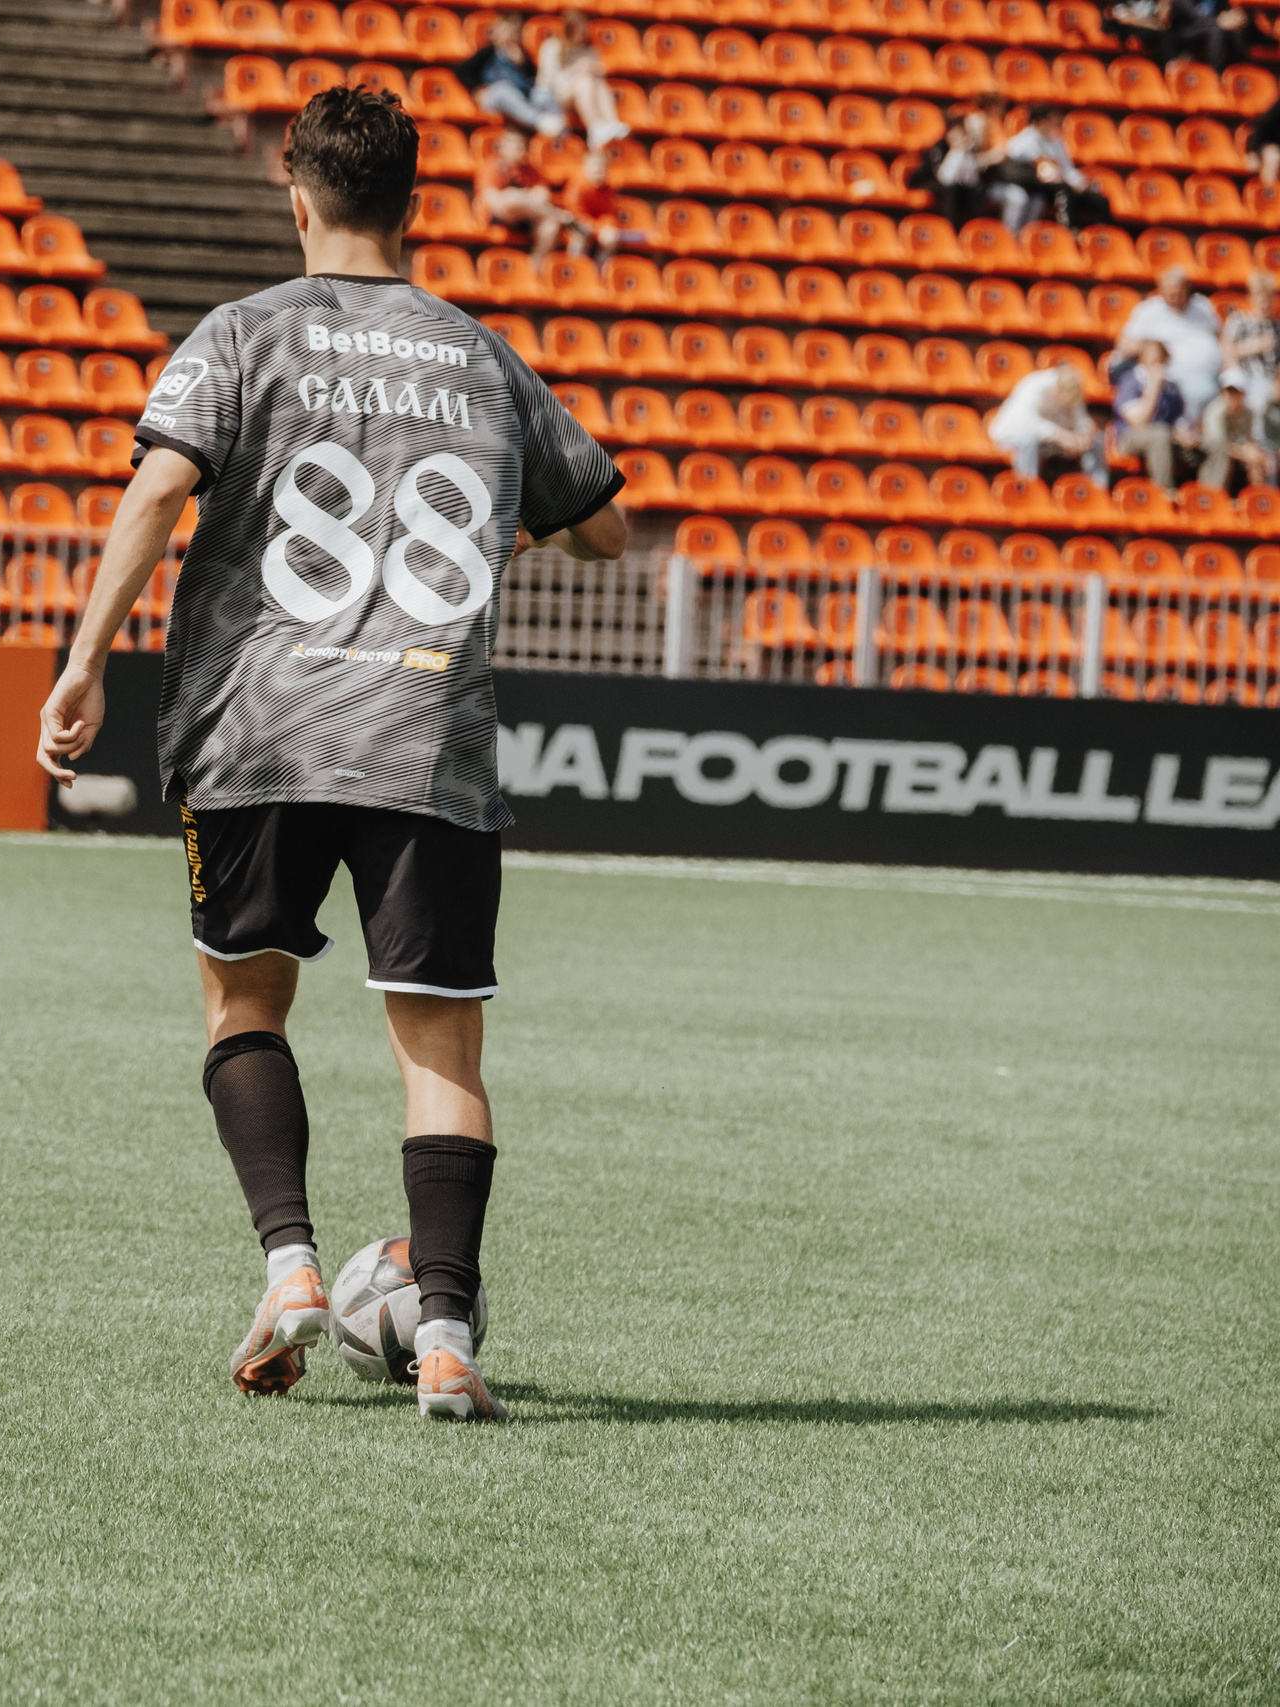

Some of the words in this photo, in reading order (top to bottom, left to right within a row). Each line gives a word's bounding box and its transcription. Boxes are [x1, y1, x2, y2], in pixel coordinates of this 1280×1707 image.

[307, 324, 468, 368] BetBoom
[261, 441, 494, 626] 88
[406, 651, 446, 669] PRO
[497, 721, 612, 800] IA
[612, 726, 1140, 823] FOOTBALL
[1142, 752, 1280, 831] LE
